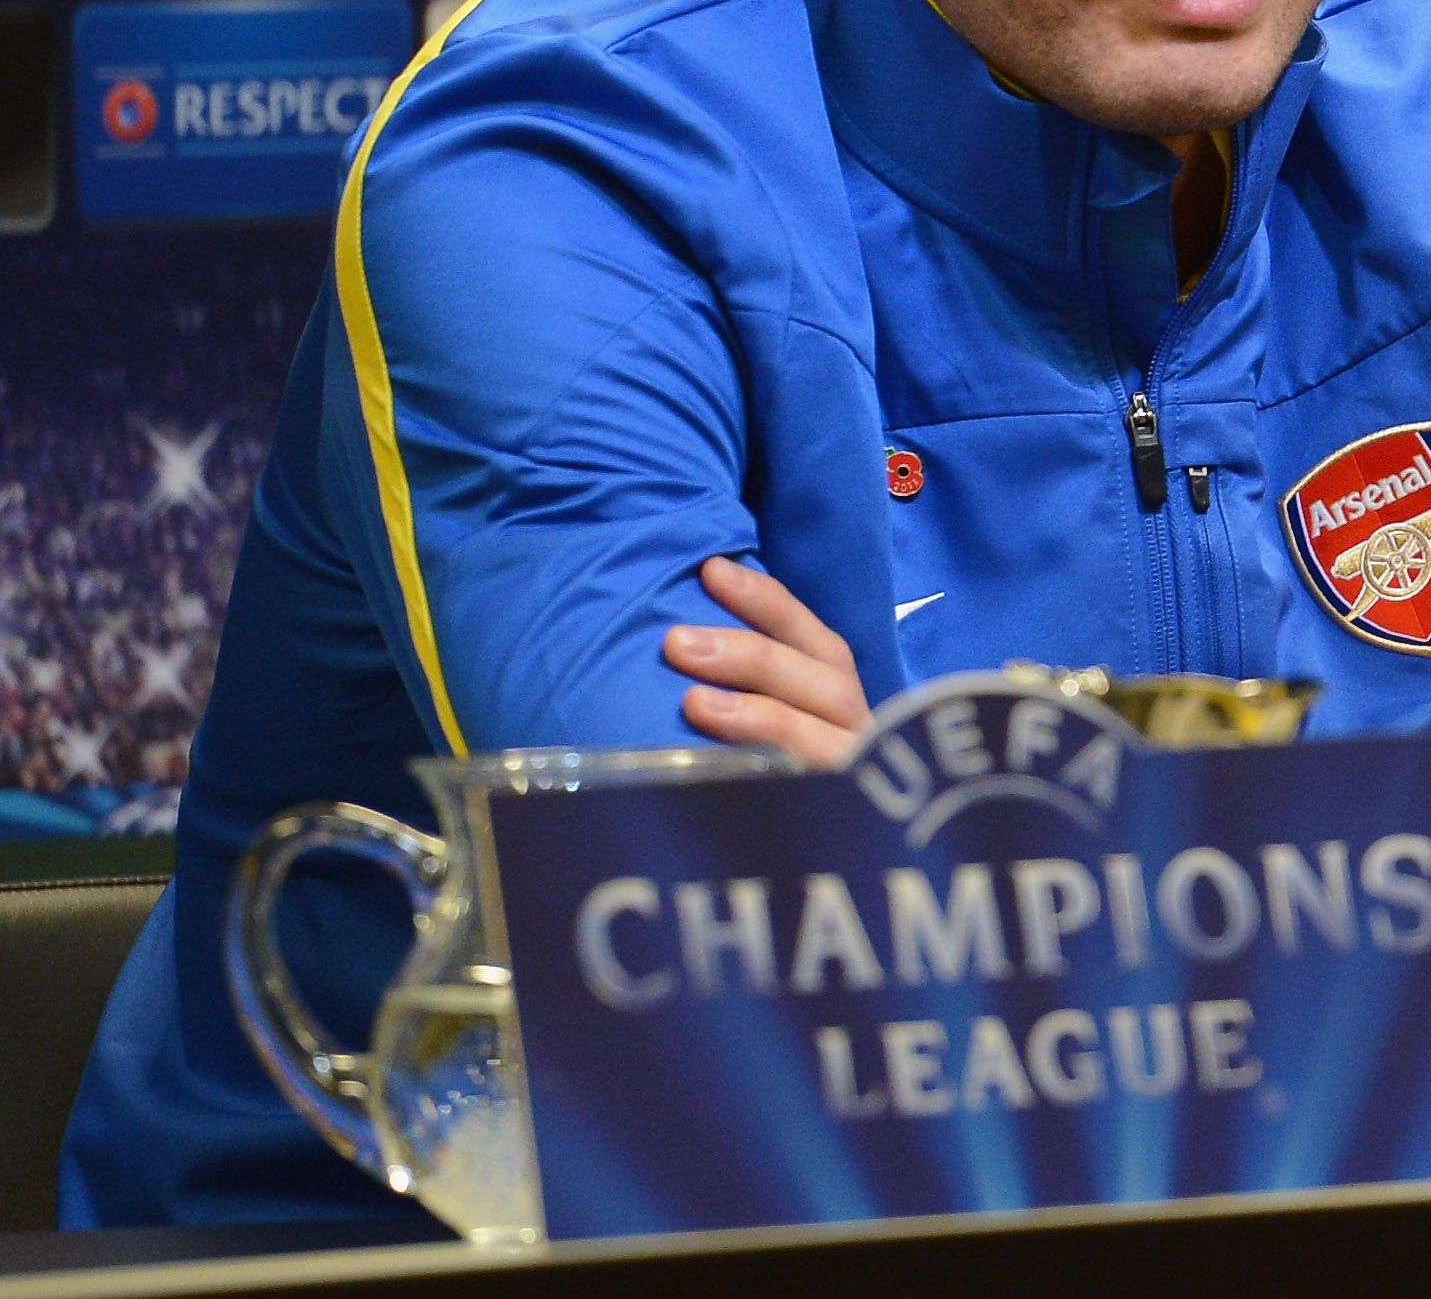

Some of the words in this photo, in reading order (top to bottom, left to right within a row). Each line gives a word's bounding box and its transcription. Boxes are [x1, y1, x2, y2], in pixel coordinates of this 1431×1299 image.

[175, 77, 389, 137] RESPECT
[852, 701, 1126, 825] UEFA
[815, 999, 1264, 1119] LEAGUE
